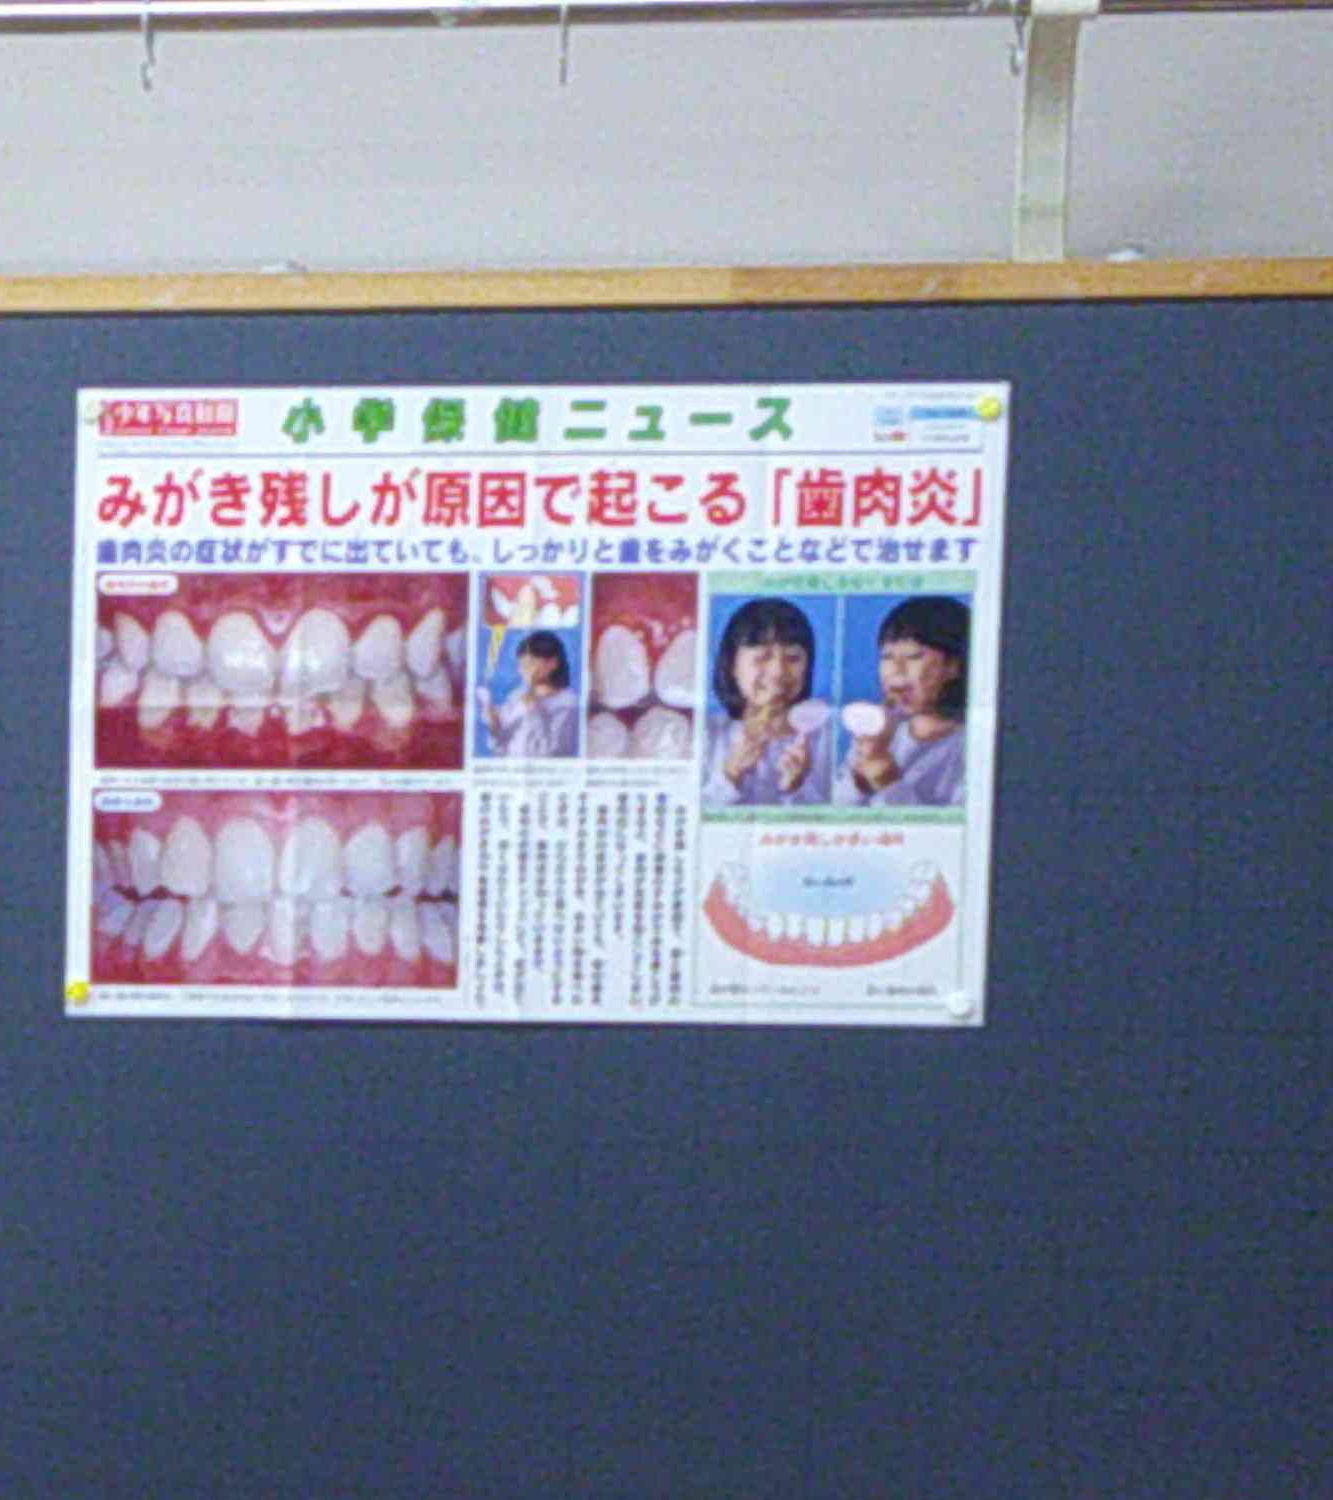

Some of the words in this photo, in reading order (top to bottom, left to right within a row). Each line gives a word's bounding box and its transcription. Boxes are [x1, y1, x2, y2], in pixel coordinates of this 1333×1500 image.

[97, 467, 982, 528] みがき残しが原因で起こる「歯肉炎」
